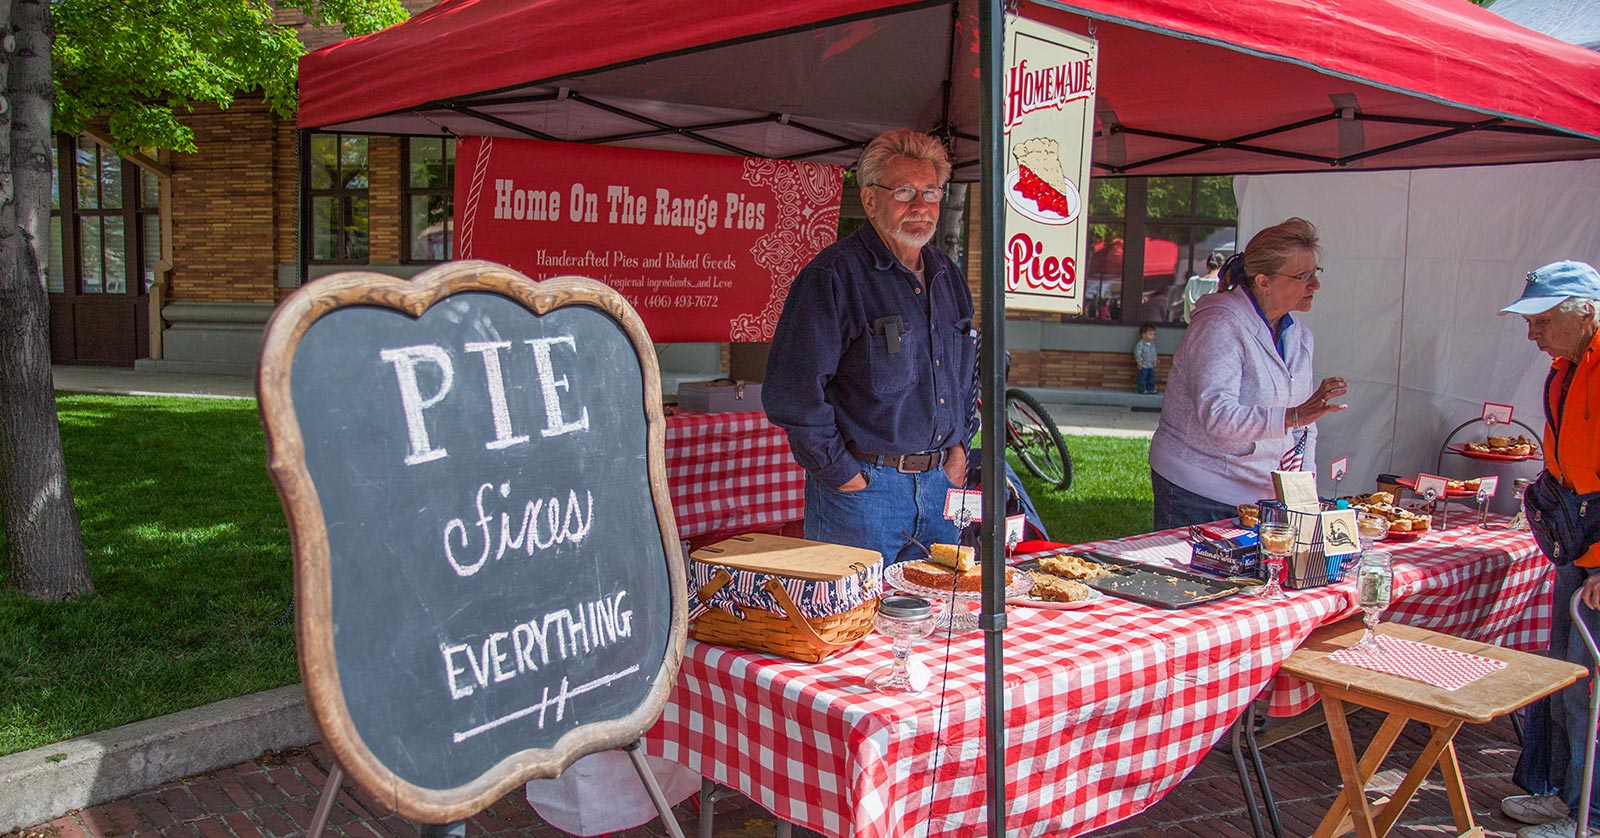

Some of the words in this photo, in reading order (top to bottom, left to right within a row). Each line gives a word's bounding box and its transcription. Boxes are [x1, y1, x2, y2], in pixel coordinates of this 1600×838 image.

[494, 179, 560, 221] Home
[569, 183, 598, 222] On
[607, 185, 647, 225] The
[654, 187, 718, 235] Range
[724, 192, 765, 230] Pies
[536, 248, 609, 267] Handcrafted
[613, 250, 639, 268] Pies
[642, 252, 662, 268] and
[666, 252, 699, 269] Baked
[702, 252, 736, 270] Goods
[713, 276, 733, 288] Love
[1006, 232, 1076, 290] Pies
[644, 295, 672, 308] (406)
[675, 295, 719, 308] 493-7672
[380, 335, 590, 465] PIE
[443, 480, 593, 577] fixes
[440, 590, 633, 700] EVERYTHING
